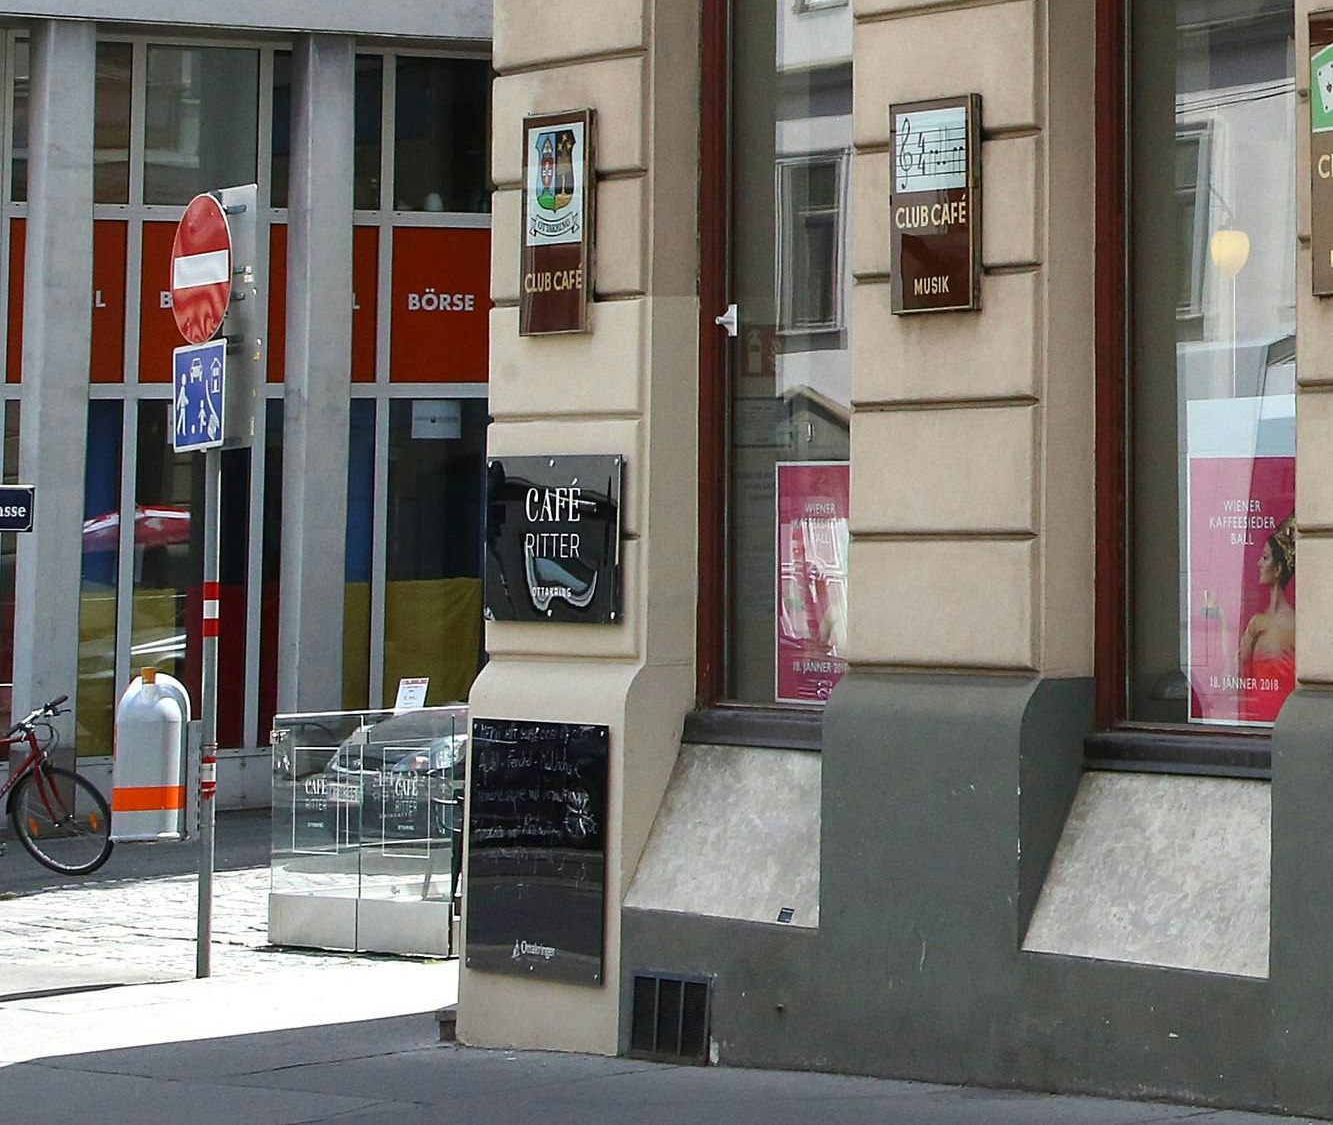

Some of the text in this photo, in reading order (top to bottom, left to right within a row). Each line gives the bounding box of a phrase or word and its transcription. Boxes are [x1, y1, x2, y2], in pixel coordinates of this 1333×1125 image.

[895, 194, 966, 229] CLUB CAFÉ
[524, 263, 582, 294] CLUB CAFÉ
[914, 276, 950, 296] MUSIK
[408, 288, 475, 311] BÖRSE
[525, 478, 581, 523] CAFÉ
[804, 502, 836, 514] WIENER
[1223, 499, 1262, 512] WIENER
[1209, 515, 1276, 529] KAFFEESIEDER
[525, 533, 580, 559] RITTER
[1231, 532, 1254, 545] BALL
[1210, 675, 1221, 688] 18.
[1260, 678, 1279, 691] 2018
